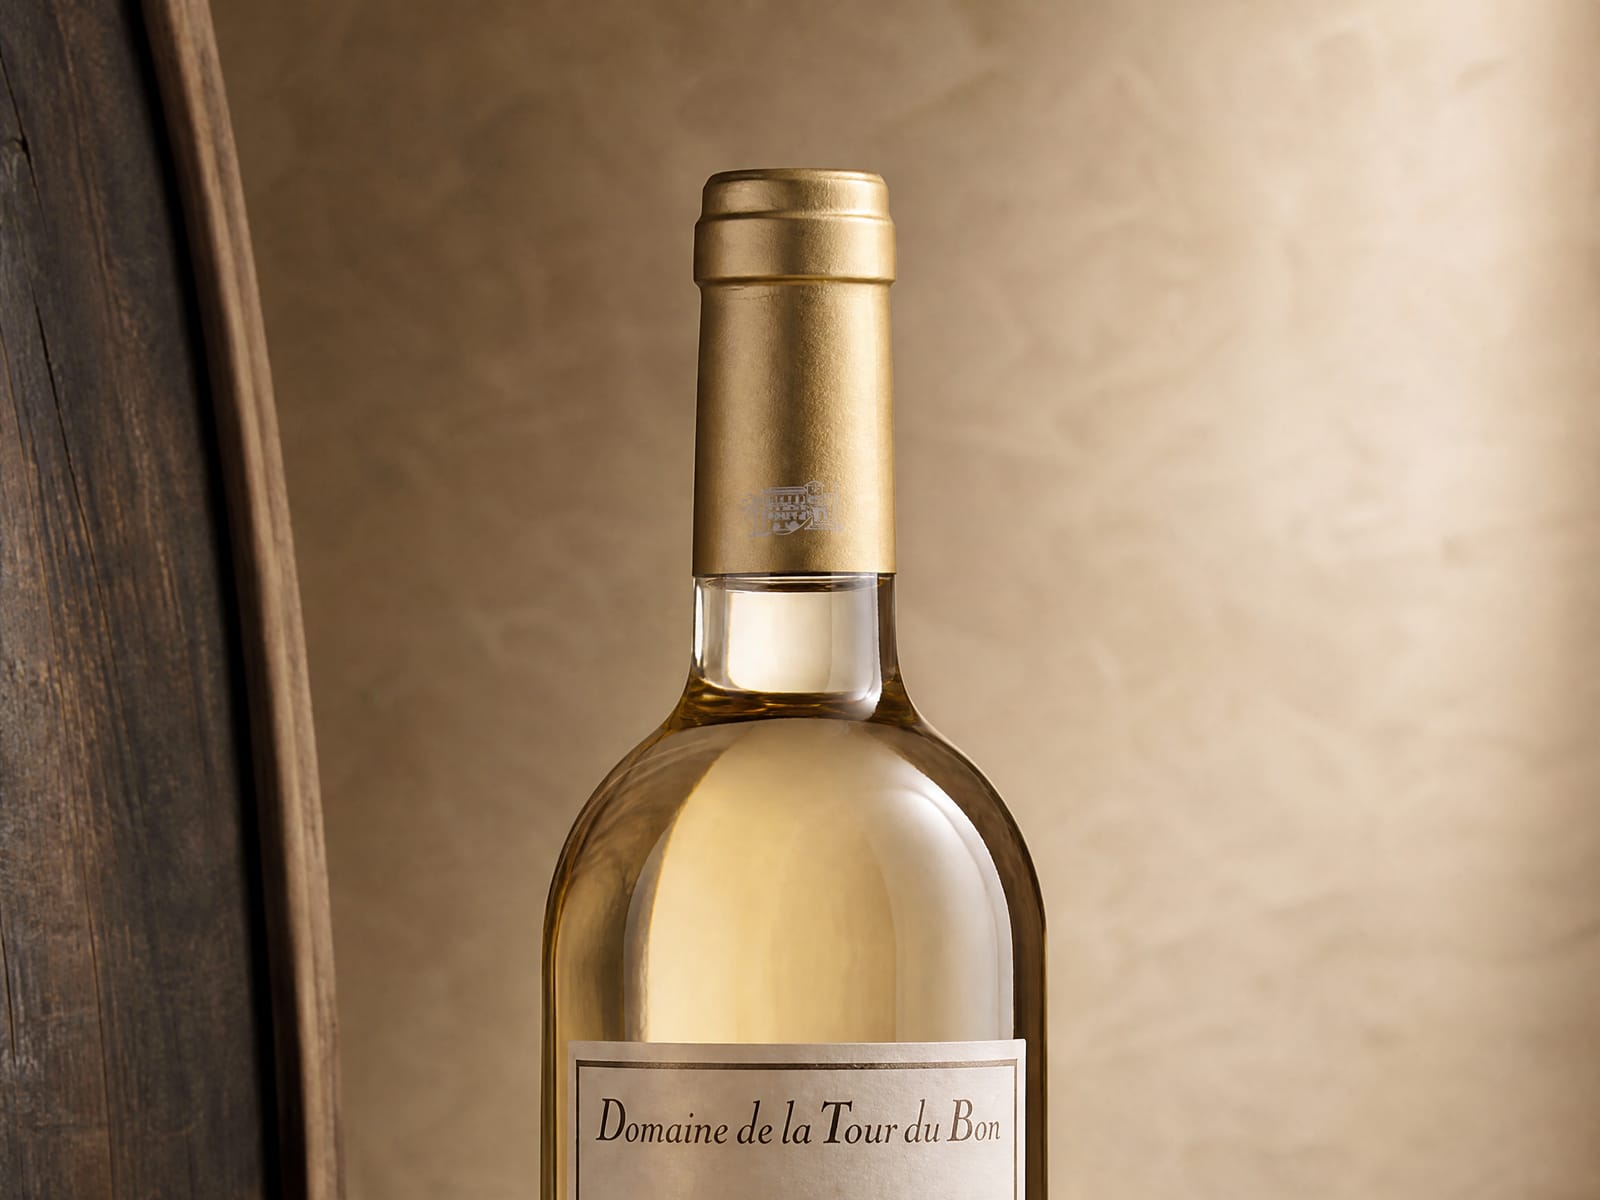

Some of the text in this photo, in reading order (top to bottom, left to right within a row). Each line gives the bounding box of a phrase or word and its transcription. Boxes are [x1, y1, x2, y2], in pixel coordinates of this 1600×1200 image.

[596, 1097, 1001, 1145] Domaine de la Tour du Bon
